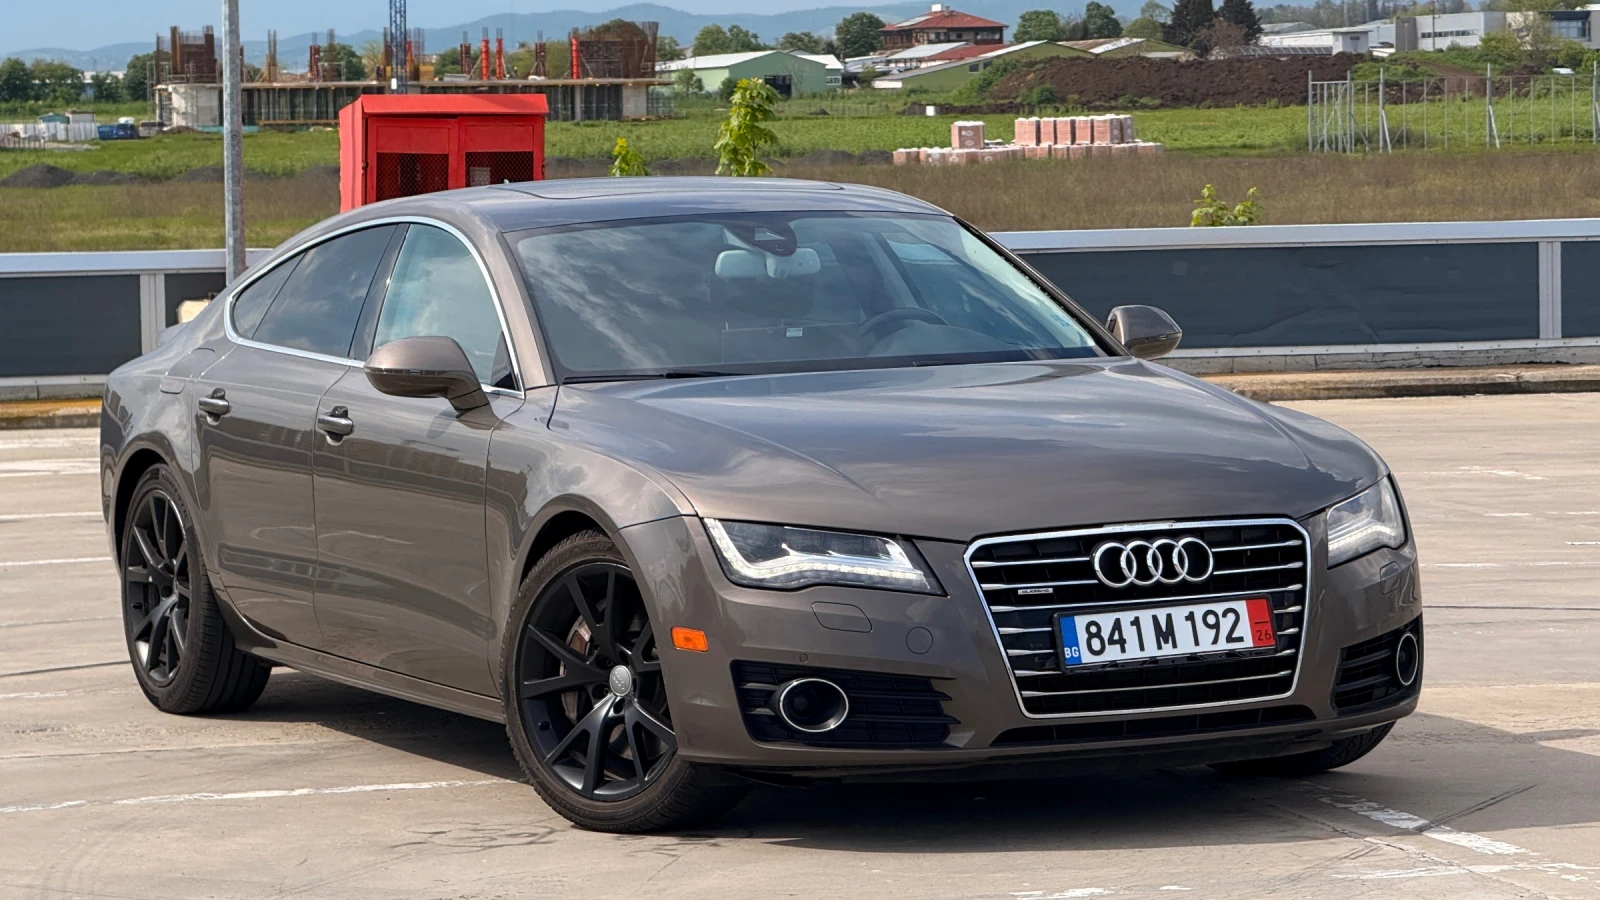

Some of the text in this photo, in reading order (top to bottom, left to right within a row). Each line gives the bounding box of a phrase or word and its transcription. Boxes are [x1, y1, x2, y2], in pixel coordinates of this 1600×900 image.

[1085, 607, 1244, 656] 841 M 192
[1256, 629, 1271, 641] 26
[1064, 647, 1079, 658] BG
